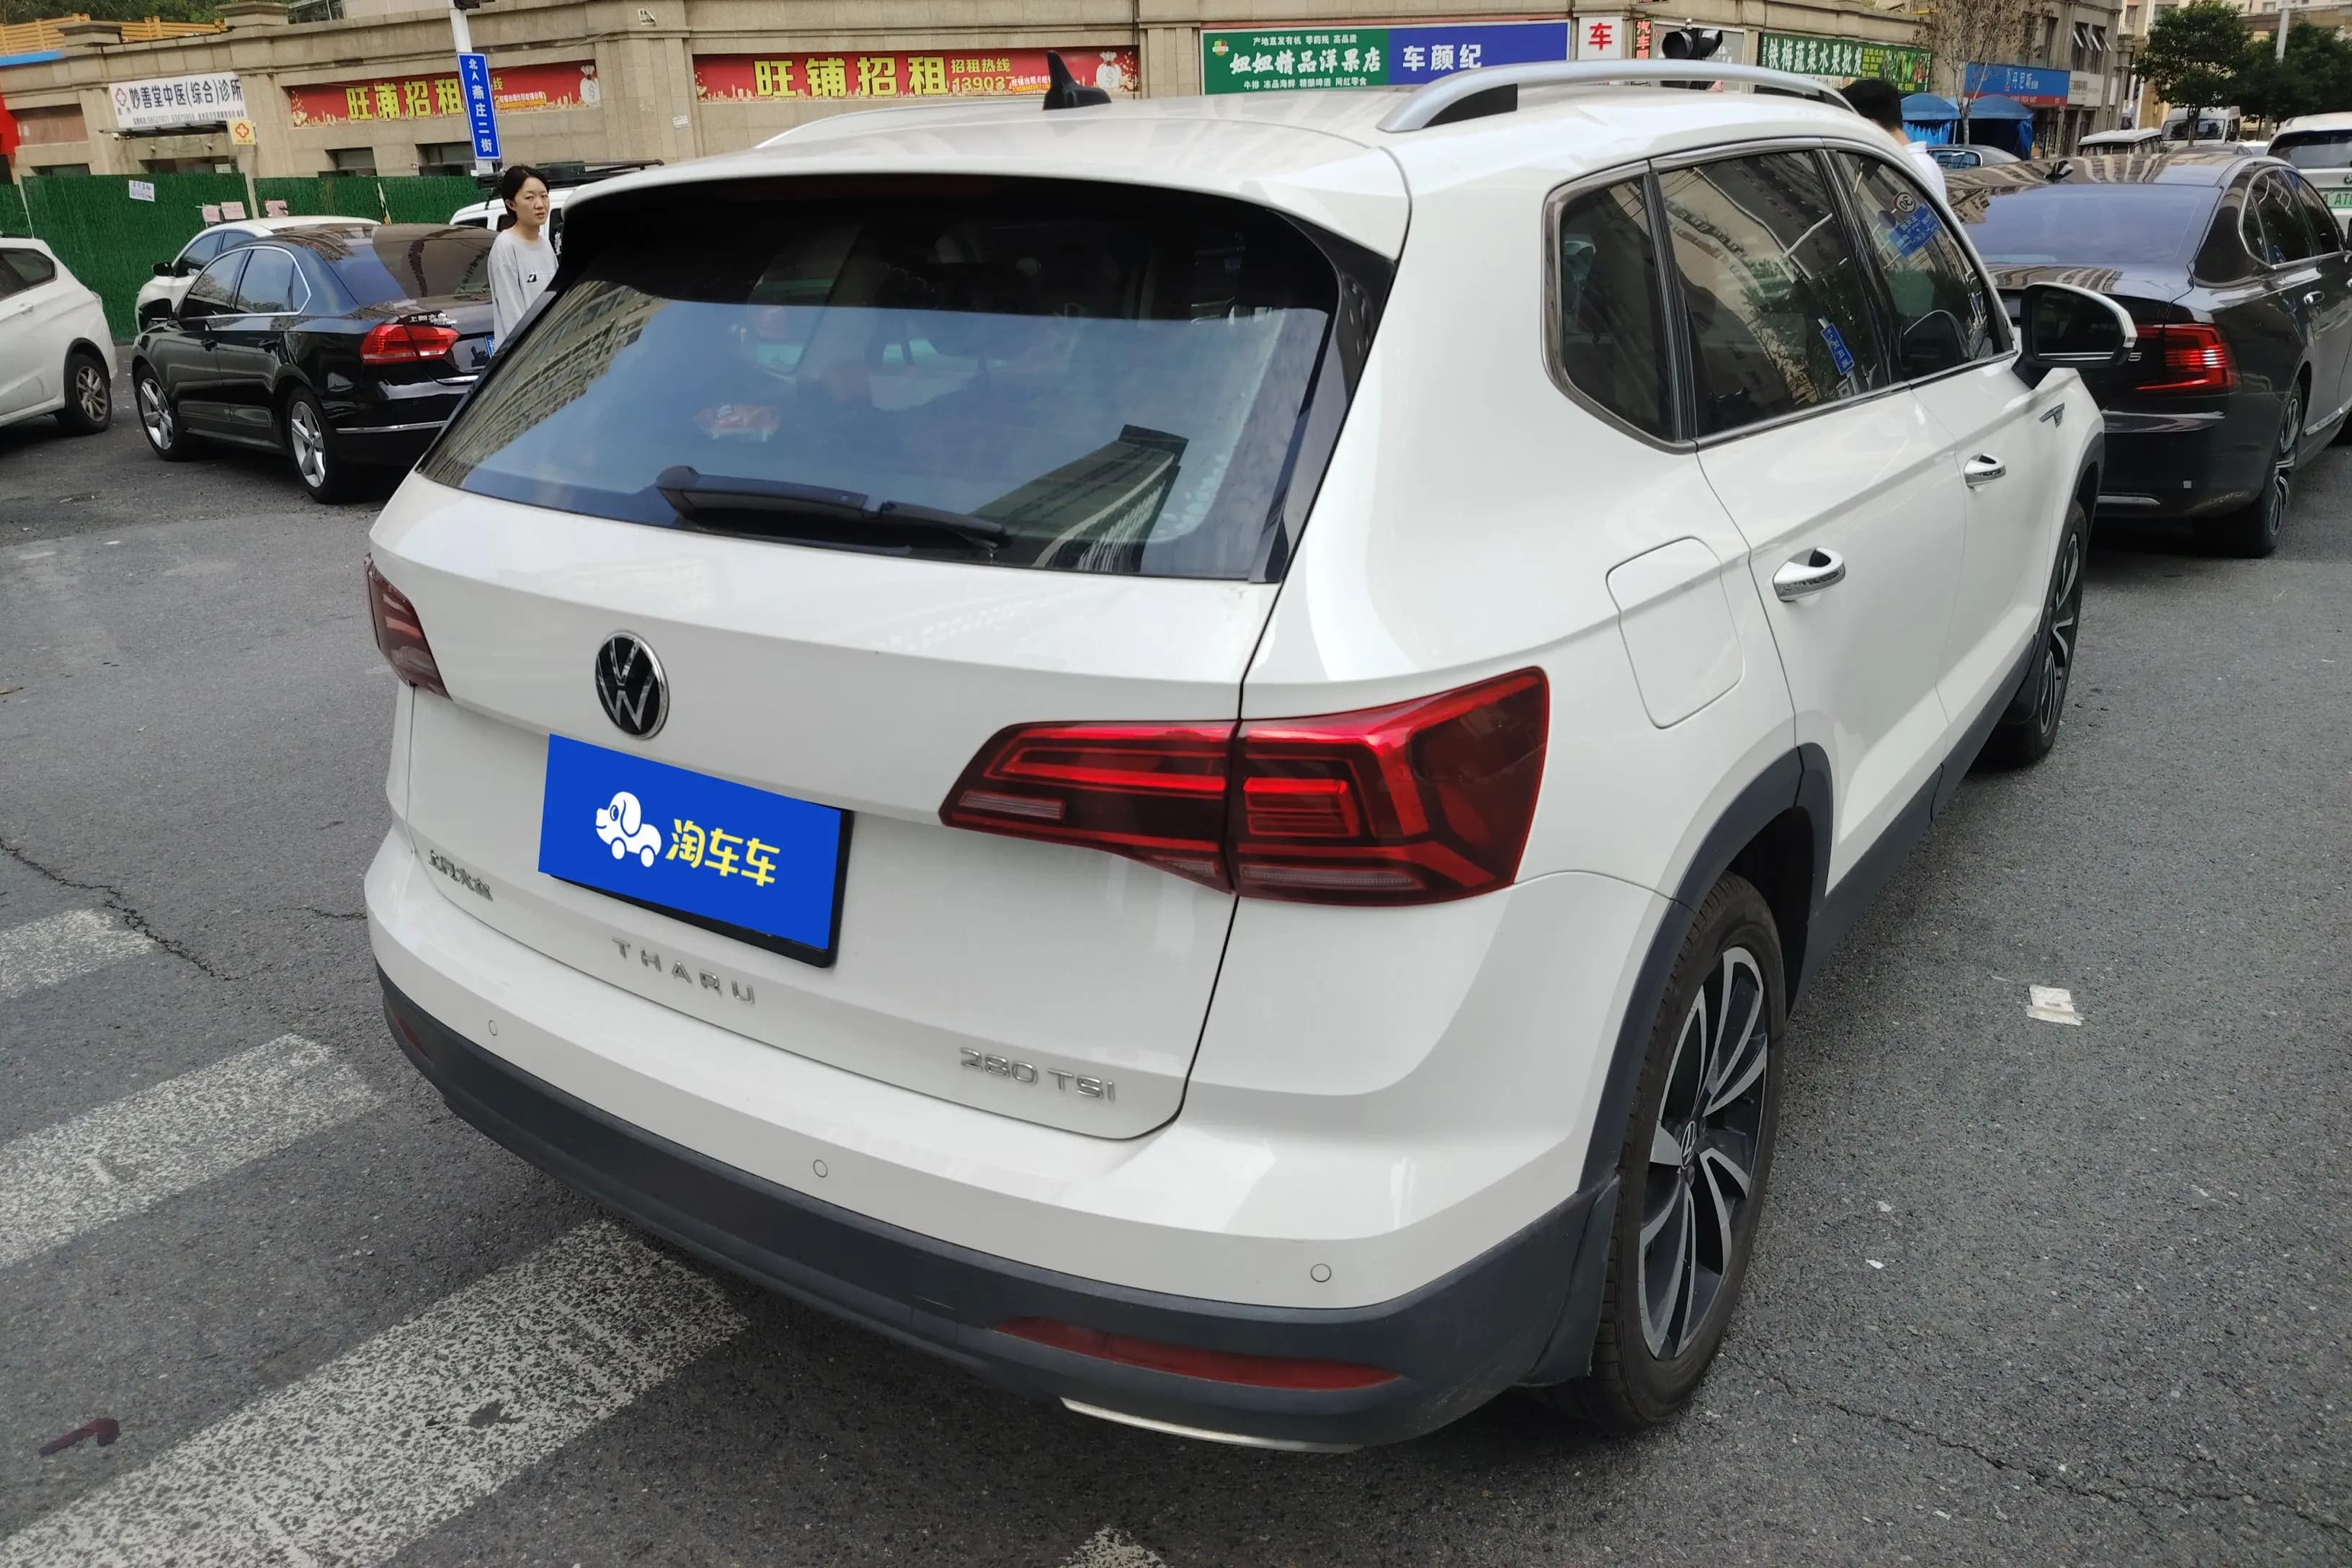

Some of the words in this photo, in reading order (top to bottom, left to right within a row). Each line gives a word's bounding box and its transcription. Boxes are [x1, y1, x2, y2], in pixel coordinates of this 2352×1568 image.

[1333, 35, 1358, 44] 高品质
[1588, 22, 1613, 50] 车
[468, 58, 478, 70] 北
[951, 58, 1011, 74] 招租热线
[1402, 44, 1482, 71] 车颜纪
[1767, 36, 1863, 76] 铁梅蔬菜水果批发
[754, 56, 949, 97] 旺铺招租
[1243, 80, 1260, 89] 牛排
[1335, 76, 1367, 86] 网红零食
[471, 84, 493, 153] 燕庄二街
[612, 937, 755, 1005] THARU
[959, 1047, 1038, 1084] 280
[1047, 1068, 1116, 1102] TSI
